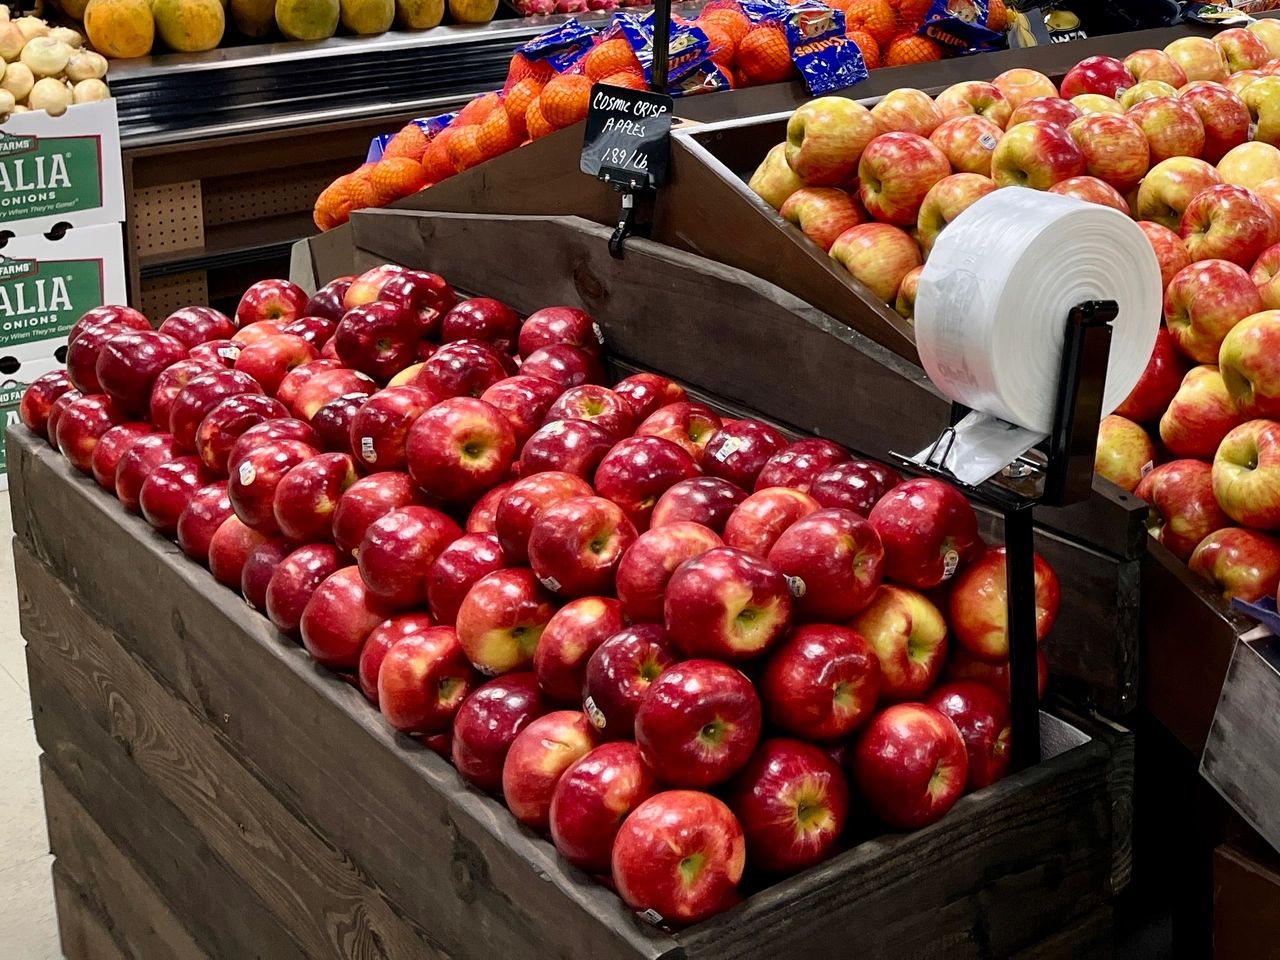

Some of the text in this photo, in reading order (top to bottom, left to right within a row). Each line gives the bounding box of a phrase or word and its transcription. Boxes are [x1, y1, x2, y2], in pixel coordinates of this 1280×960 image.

[593, 91, 667, 118] COSMIC CRISP
[602, 117, 645, 138] APPLES
[2, 191, 56, 206] ONIONS
[8, 207, 28, 216] When
[3, 315, 57, 330] ONIONS
[11, 332, 30, 340] When
